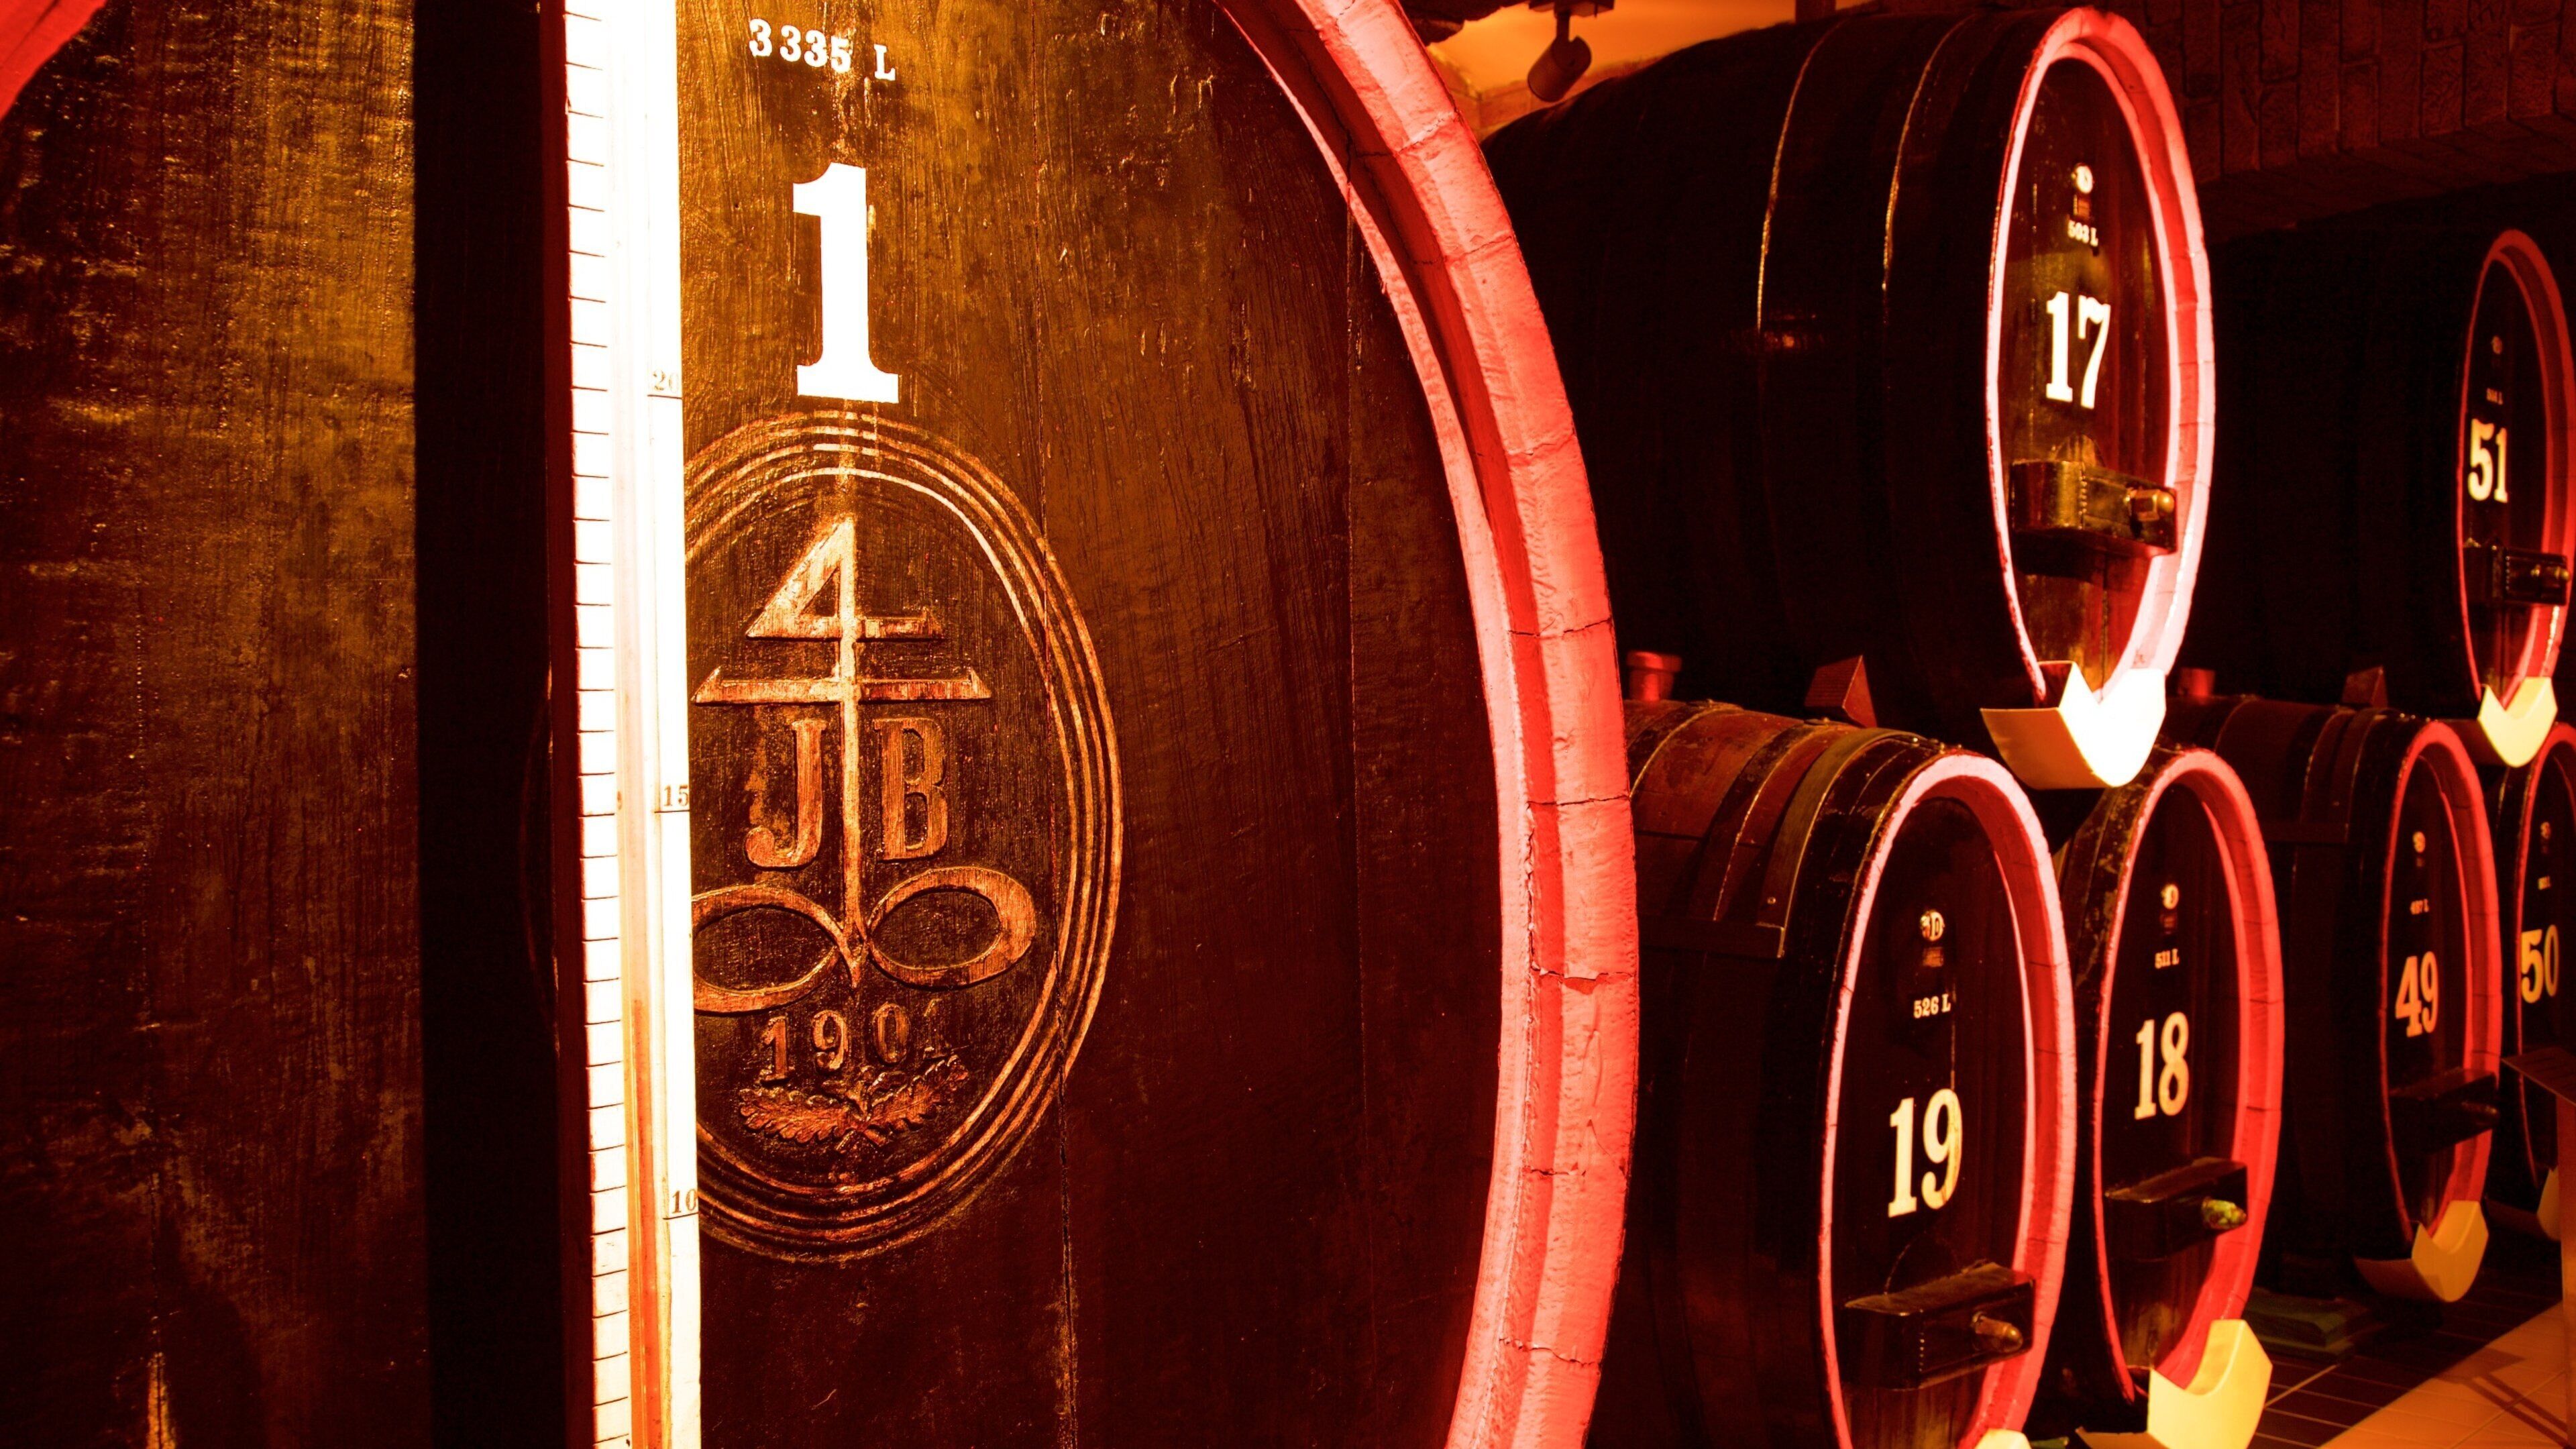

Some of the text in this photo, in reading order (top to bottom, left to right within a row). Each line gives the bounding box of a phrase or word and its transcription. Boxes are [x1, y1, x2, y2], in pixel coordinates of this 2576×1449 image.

[748, 18, 896, 81] 3335 L
[2090, 227, 2098, 248] L
[792, 162, 900, 404] 1
[2045, 290, 2111, 410] 17
[2467, 417, 2508, 503] 51
[663, 784, 689, 807] 15
[2171, 947, 2180, 966] L
[2395, 951, 2439, 1038] 49
[2520, 924, 2560, 1004] 50
[1913, 993, 1951, 1018] 526 L
[2134, 1011, 2190, 1120] 18
[1887, 1087, 1963, 1218] 19
[671, 1188, 698, 1214] 10
